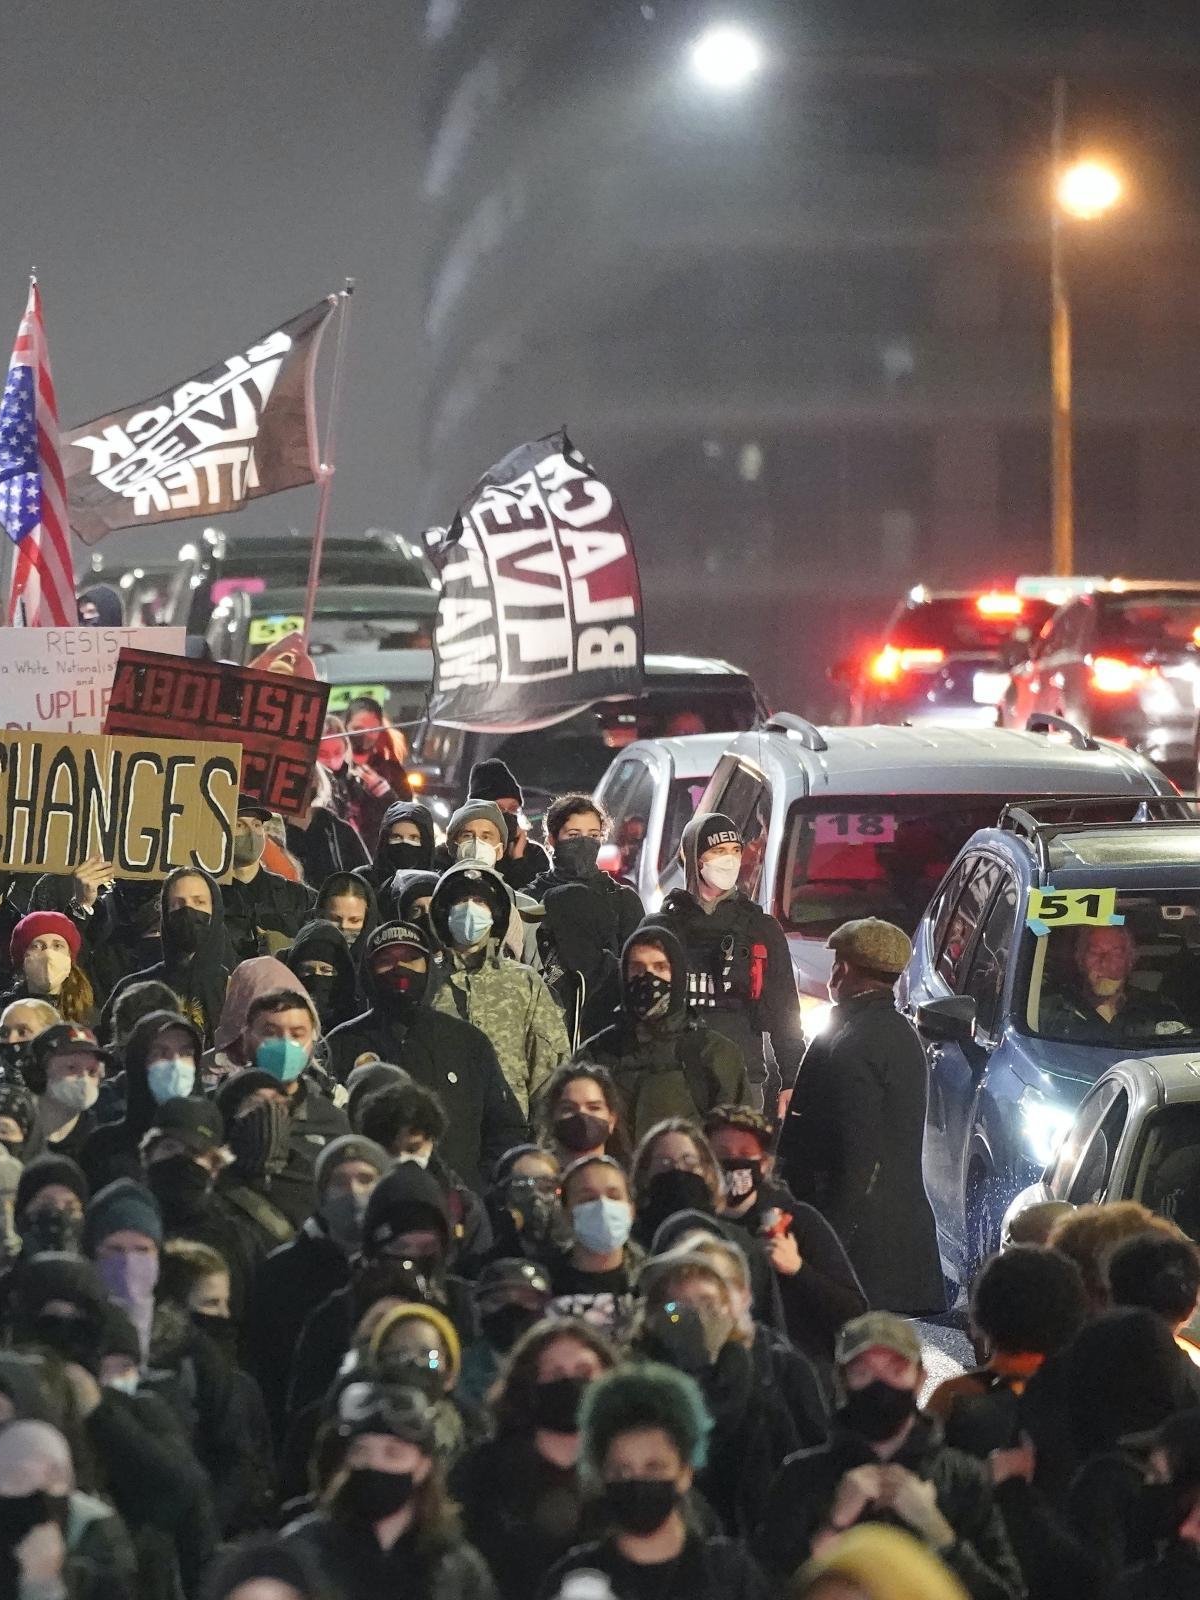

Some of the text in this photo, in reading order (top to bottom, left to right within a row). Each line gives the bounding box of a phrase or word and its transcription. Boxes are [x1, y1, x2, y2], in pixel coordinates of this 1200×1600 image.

[46, 630, 138, 655] RESIST
[15, 659, 49, 675] White
[56, 659, 119, 674] Nationalis
[76, 677, 95, 686] and
[36, 687, 112, 720] UPLIF
[111, 665, 322, 741] ABOLISH
[828, 814, 885, 836] 18
[1038, 894, 1100, 919] 51
